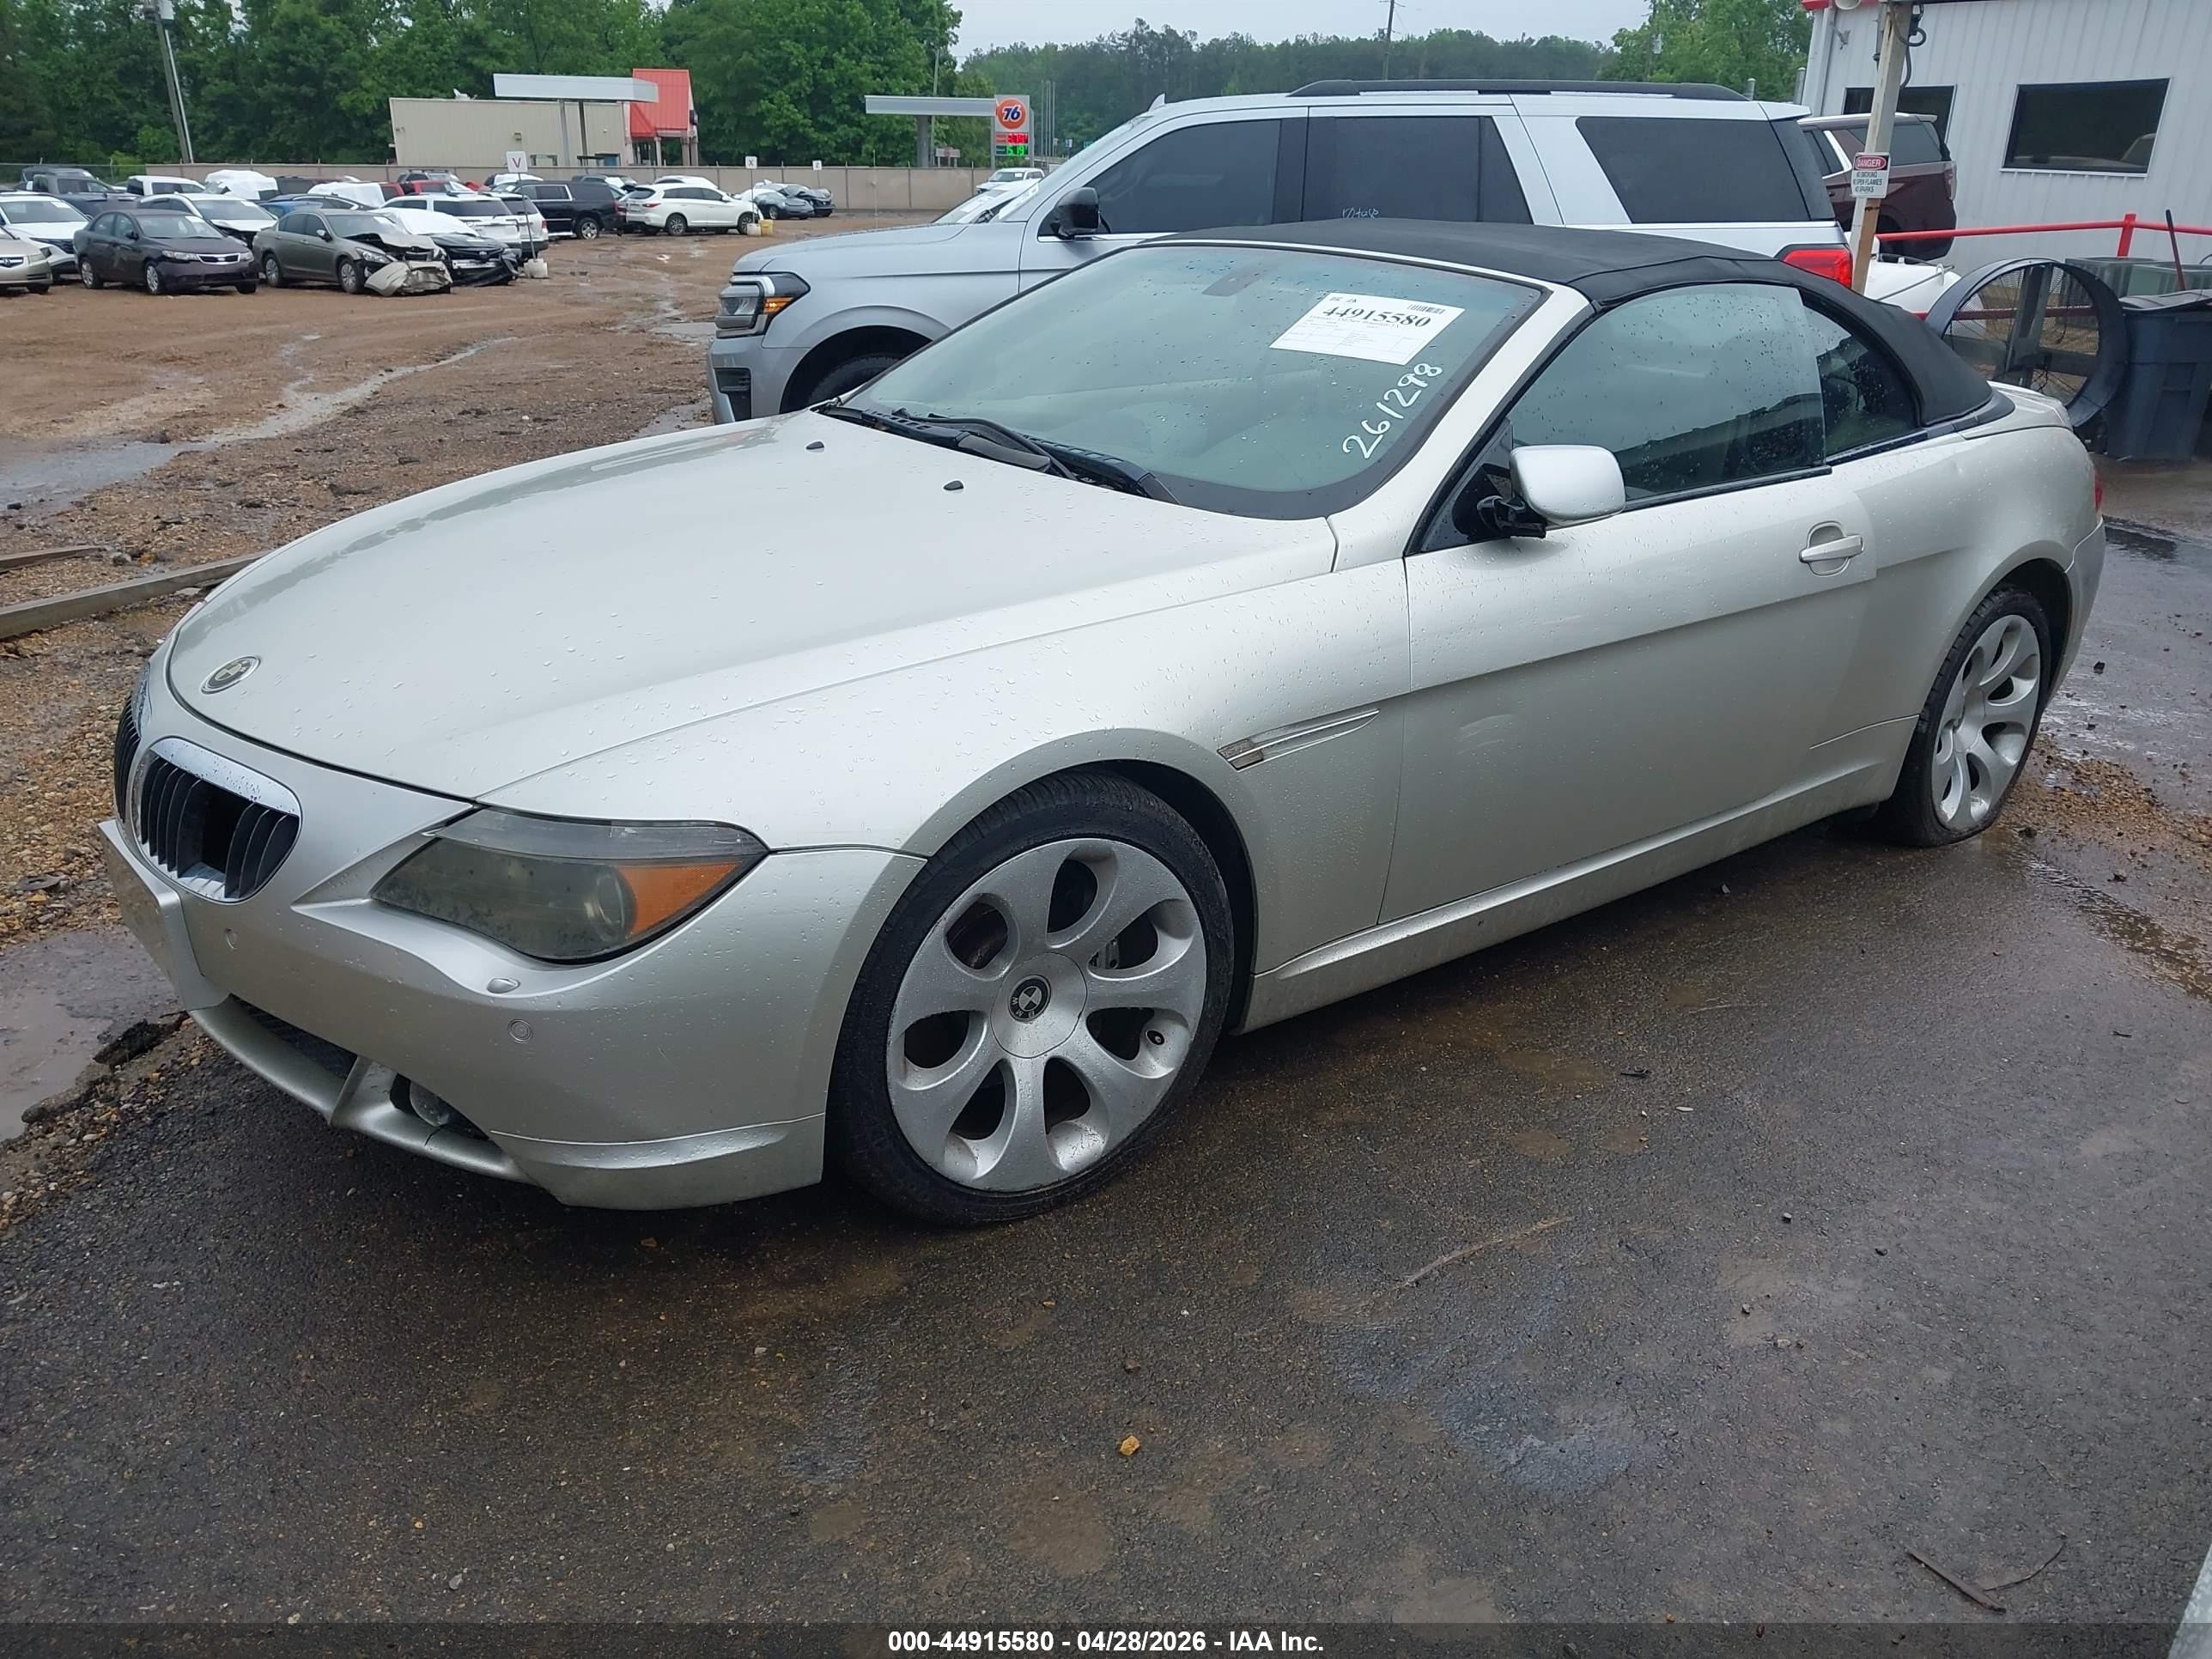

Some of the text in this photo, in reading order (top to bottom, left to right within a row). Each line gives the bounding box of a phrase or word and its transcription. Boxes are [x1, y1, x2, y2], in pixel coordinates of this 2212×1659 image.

[1002, 105, 1022, 121] 76
[512, 157, 521, 168] V
[1857, 159, 1881, 167] DANGER
[1322, 305, 1431, 328] 44915580
[1342, 362, 1443, 459] 261298
[1012, 997, 1036, 1018] BMW
